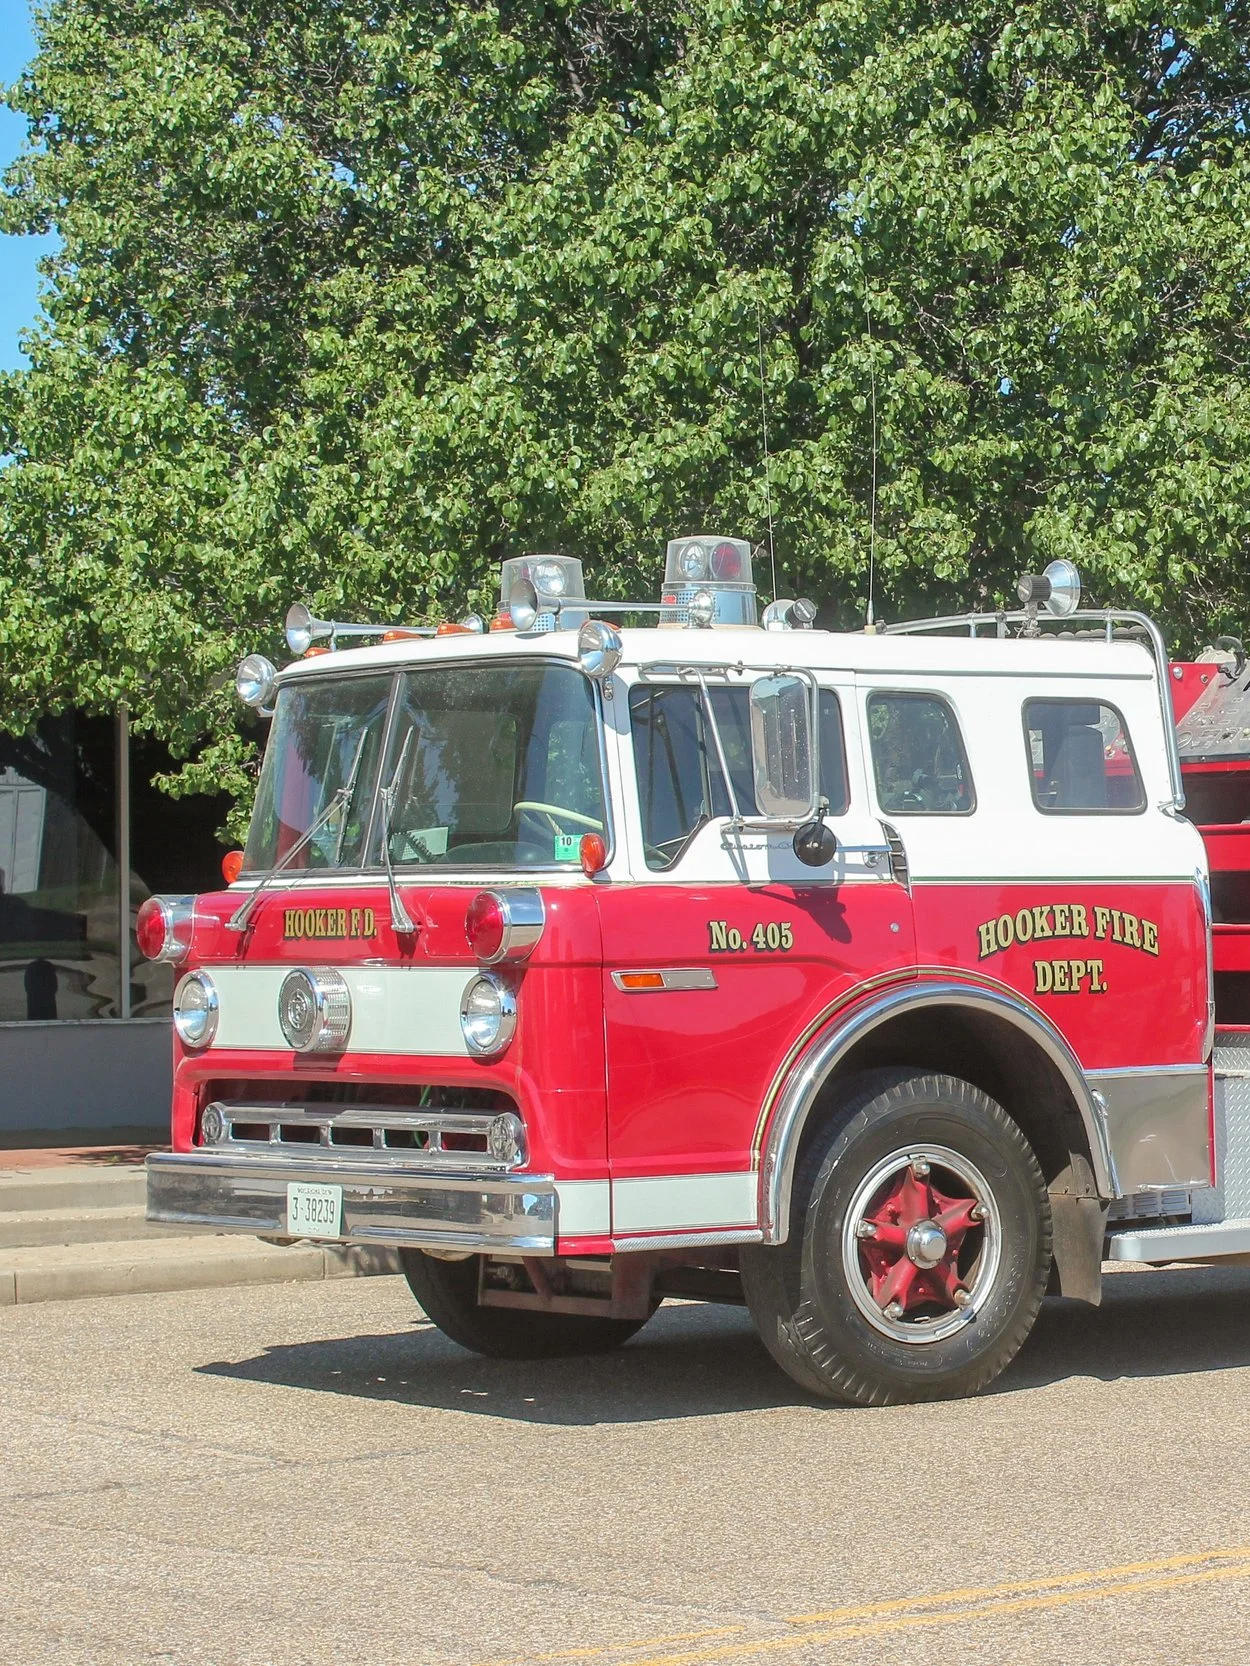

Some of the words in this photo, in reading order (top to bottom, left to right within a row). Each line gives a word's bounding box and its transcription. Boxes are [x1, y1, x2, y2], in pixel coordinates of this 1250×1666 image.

[561, 836, 572, 846] 10
[284, 908, 347, 938] HOOKER
[708, 920, 748, 952] No.
[751, 921, 794, 951] 405
[978, 904, 1090, 960] HOOKER
[1093, 905, 1160, 956] FIRE
[1034, 958, 1109, 994] DEPT.
[292, 1196, 335, 1224] 3-38239
